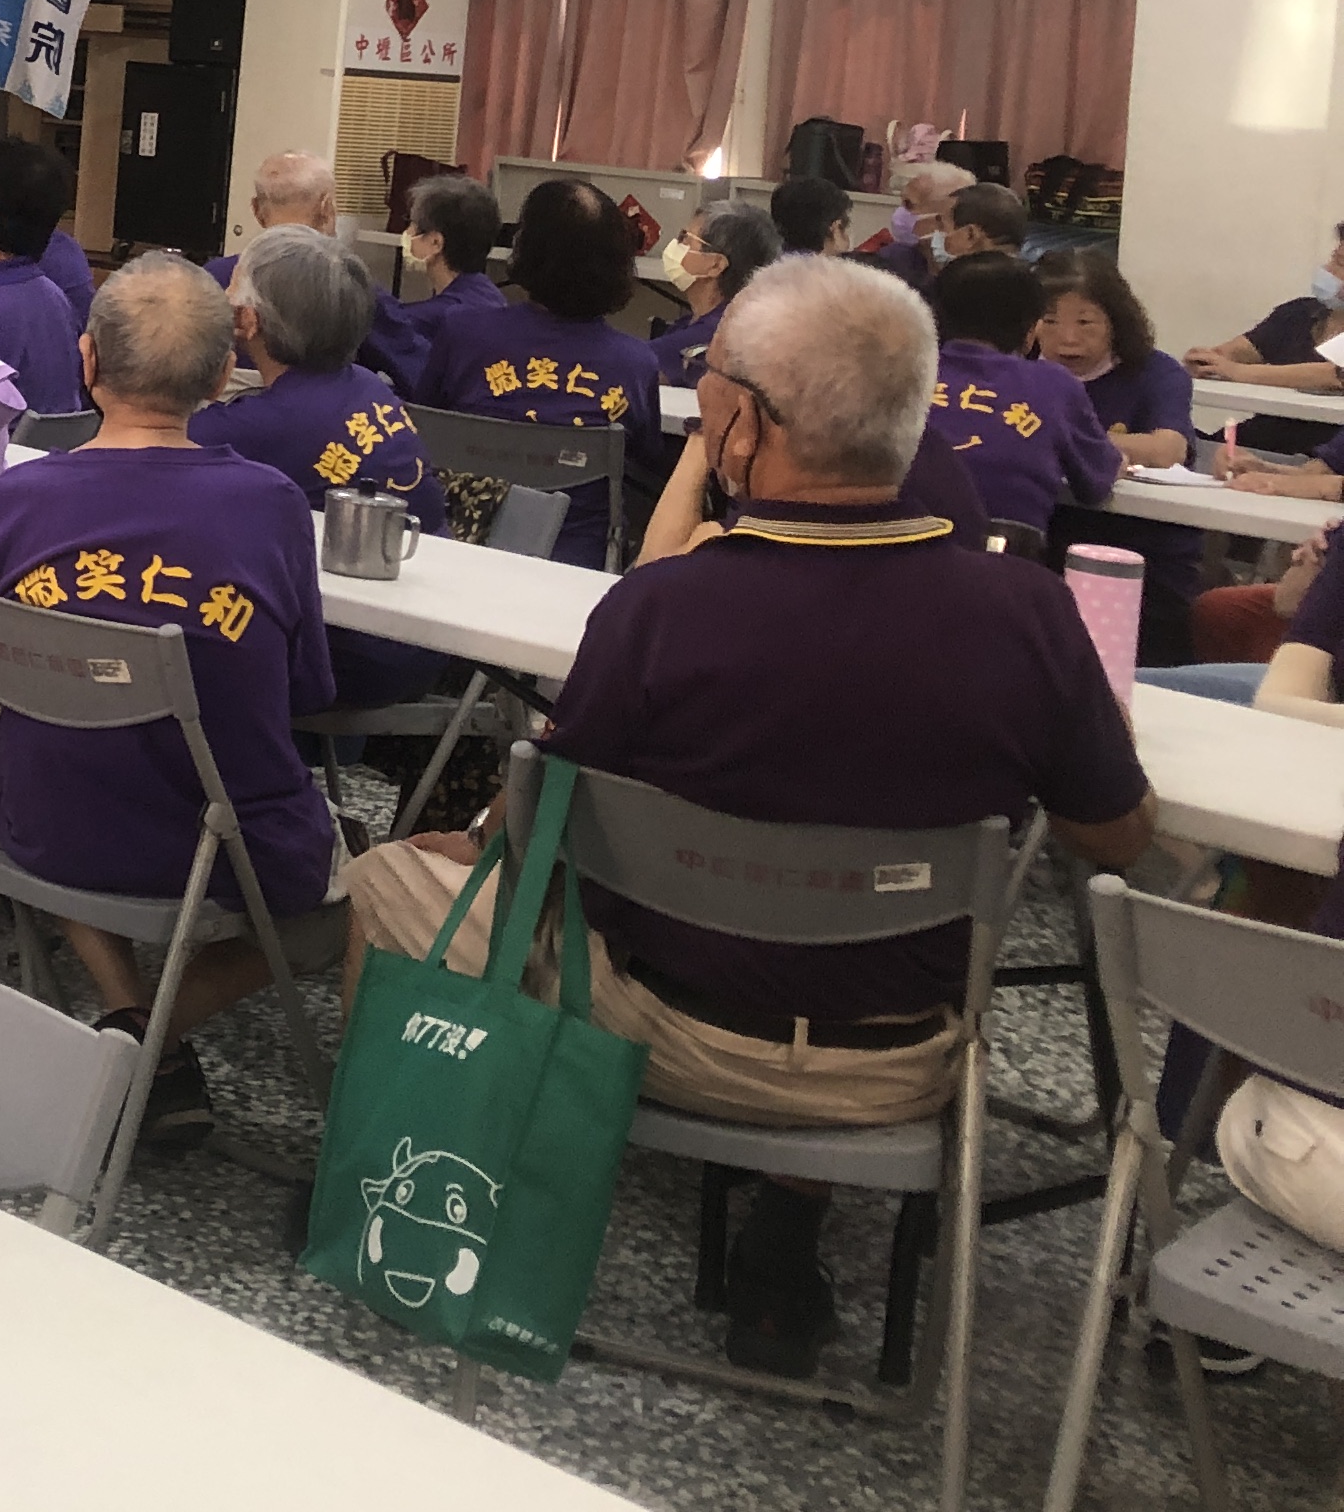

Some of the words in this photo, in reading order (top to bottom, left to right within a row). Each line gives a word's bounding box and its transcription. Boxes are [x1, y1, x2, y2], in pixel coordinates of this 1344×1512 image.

[484, 356, 629, 422] 微笑仁和
[313, 401, 418, 486] 微笑仁
[14, 548, 255, 643] 微笑仁和
